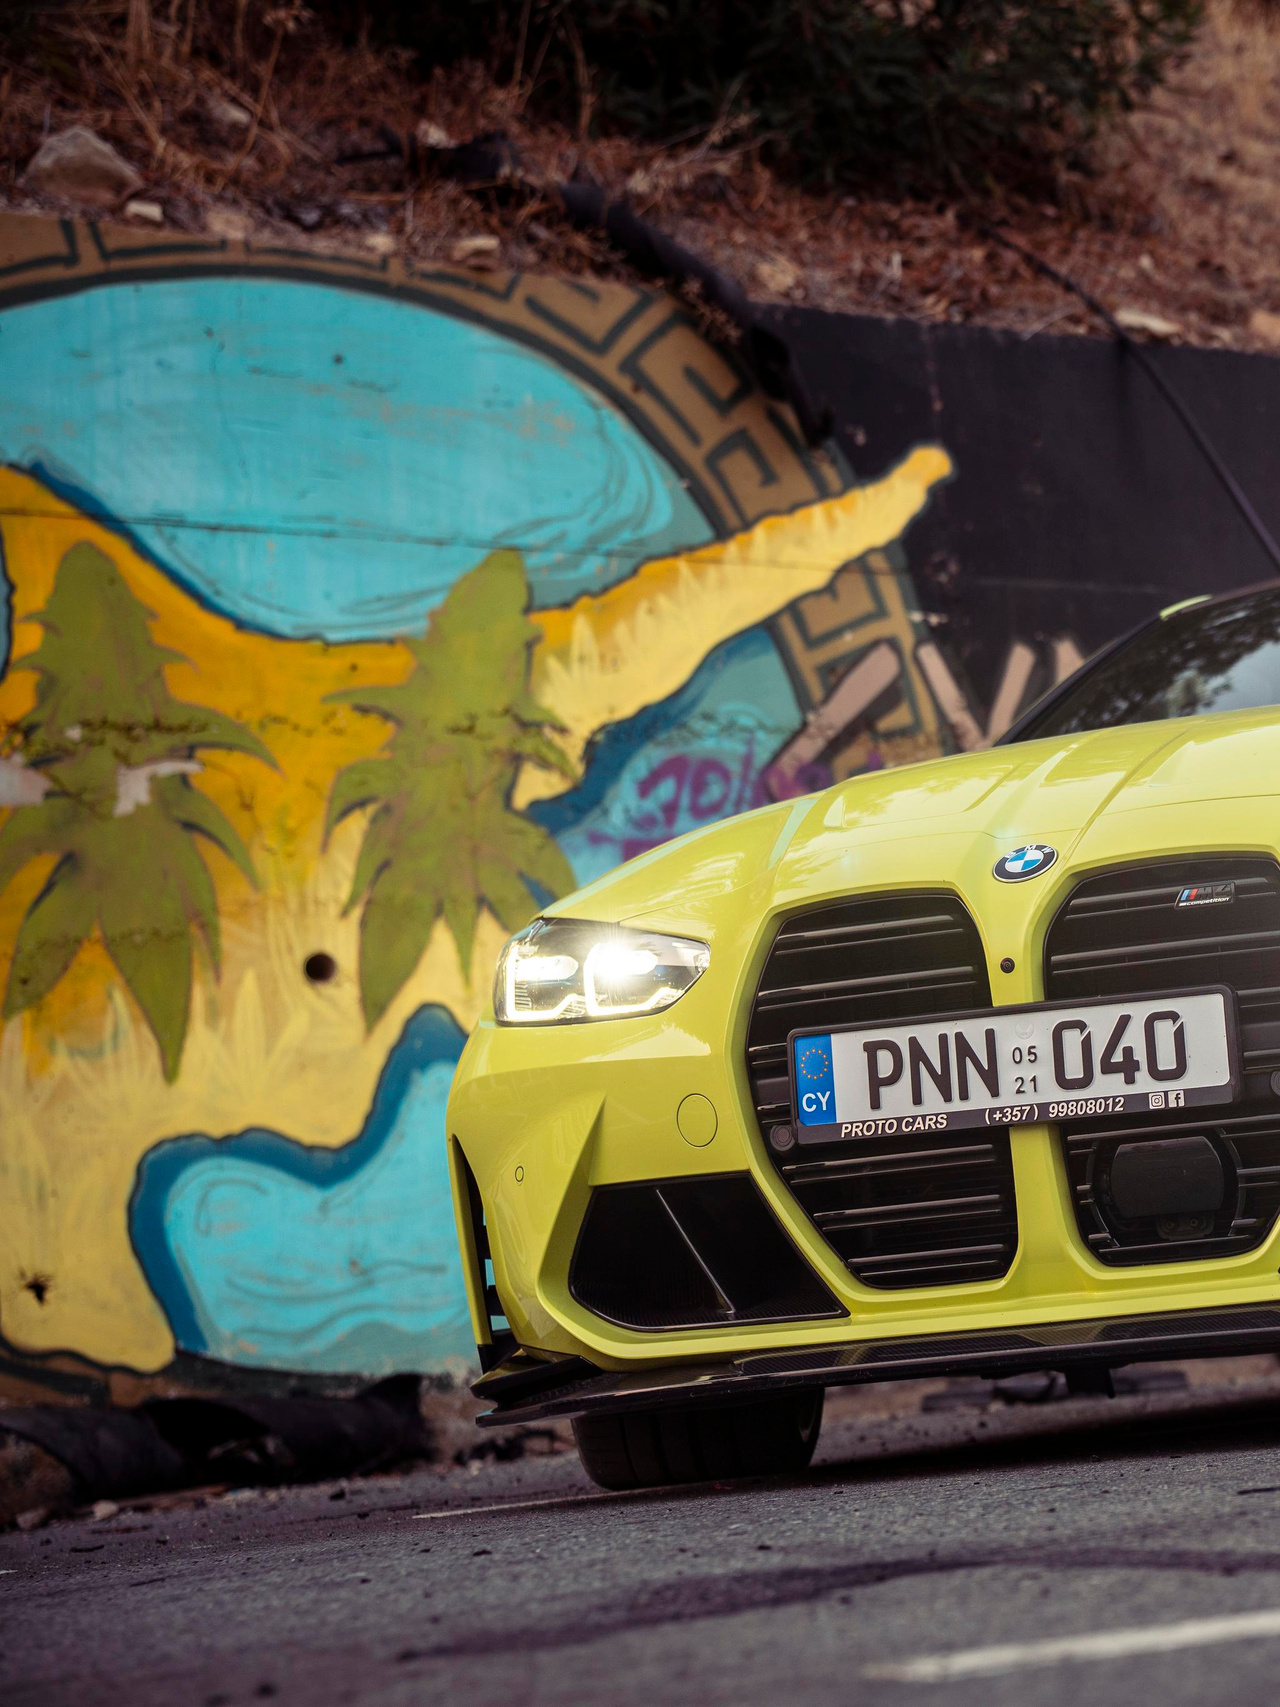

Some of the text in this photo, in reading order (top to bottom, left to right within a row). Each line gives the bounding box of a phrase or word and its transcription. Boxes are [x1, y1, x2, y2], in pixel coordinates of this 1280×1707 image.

[1005, 844, 1054, 859] BMW
[863, 1010, 1187, 1109] PNN 040
[1012, 1045, 1038, 1064] 05
[1015, 1075, 1038, 1094] 21
[802, 1090, 831, 1112] CY
[841, 1096, 1125, 1138] PROTO CARS (+357) 99808012
